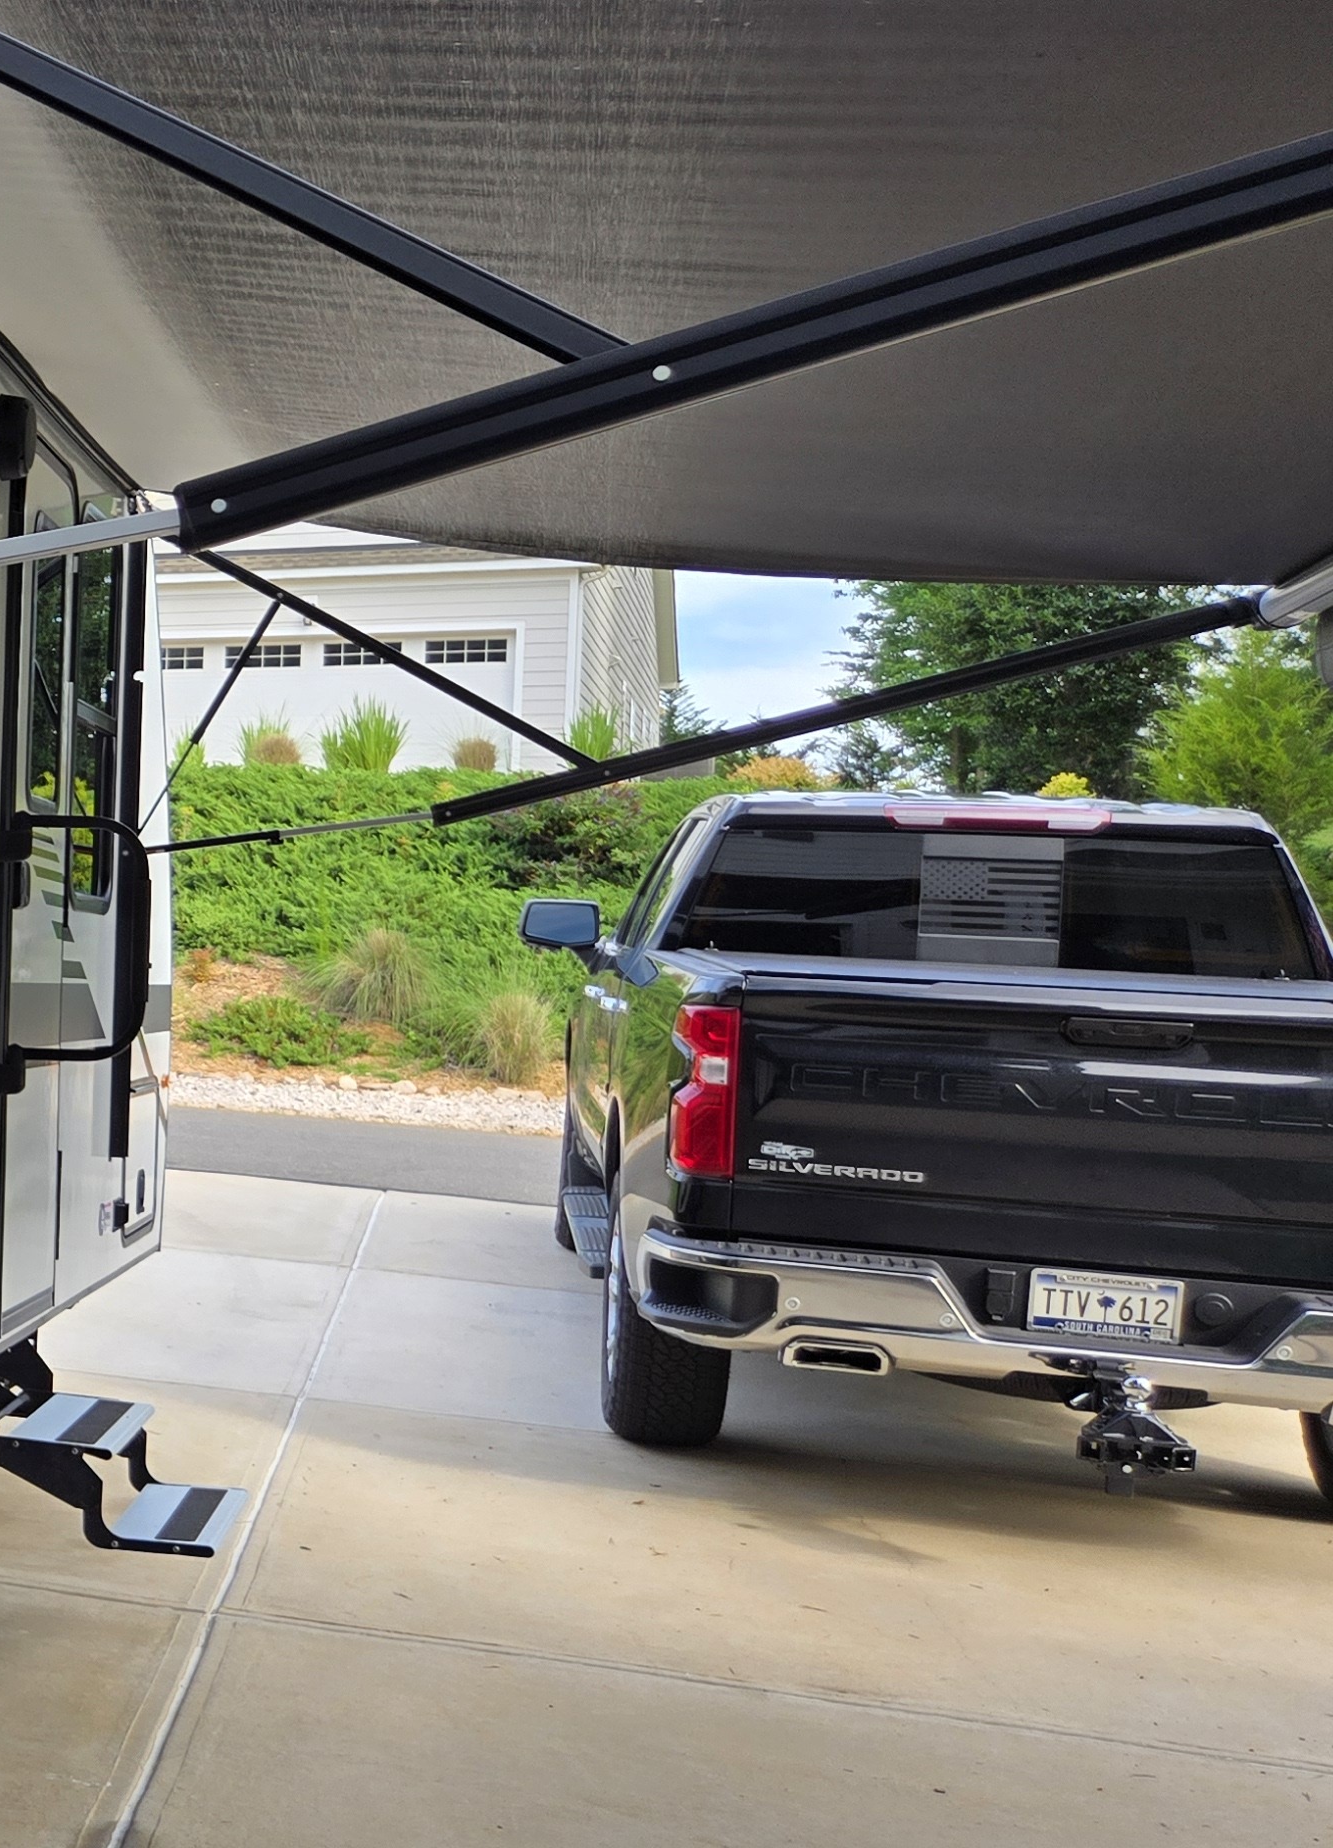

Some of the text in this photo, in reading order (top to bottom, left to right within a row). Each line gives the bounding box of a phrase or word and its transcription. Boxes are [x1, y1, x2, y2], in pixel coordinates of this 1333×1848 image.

[791, 1062, 1333, 1127] CHEVROL
[748, 1158, 925, 1183] SILVERADO
[1091, 1277, 1147, 1287] CHEVROLET
[1043, 1288, 1169, 1326] TTV 612
[1064, 1321, 1094, 1332] SOUTH
[1096, 1323, 1142, 1336] CAROLINA
